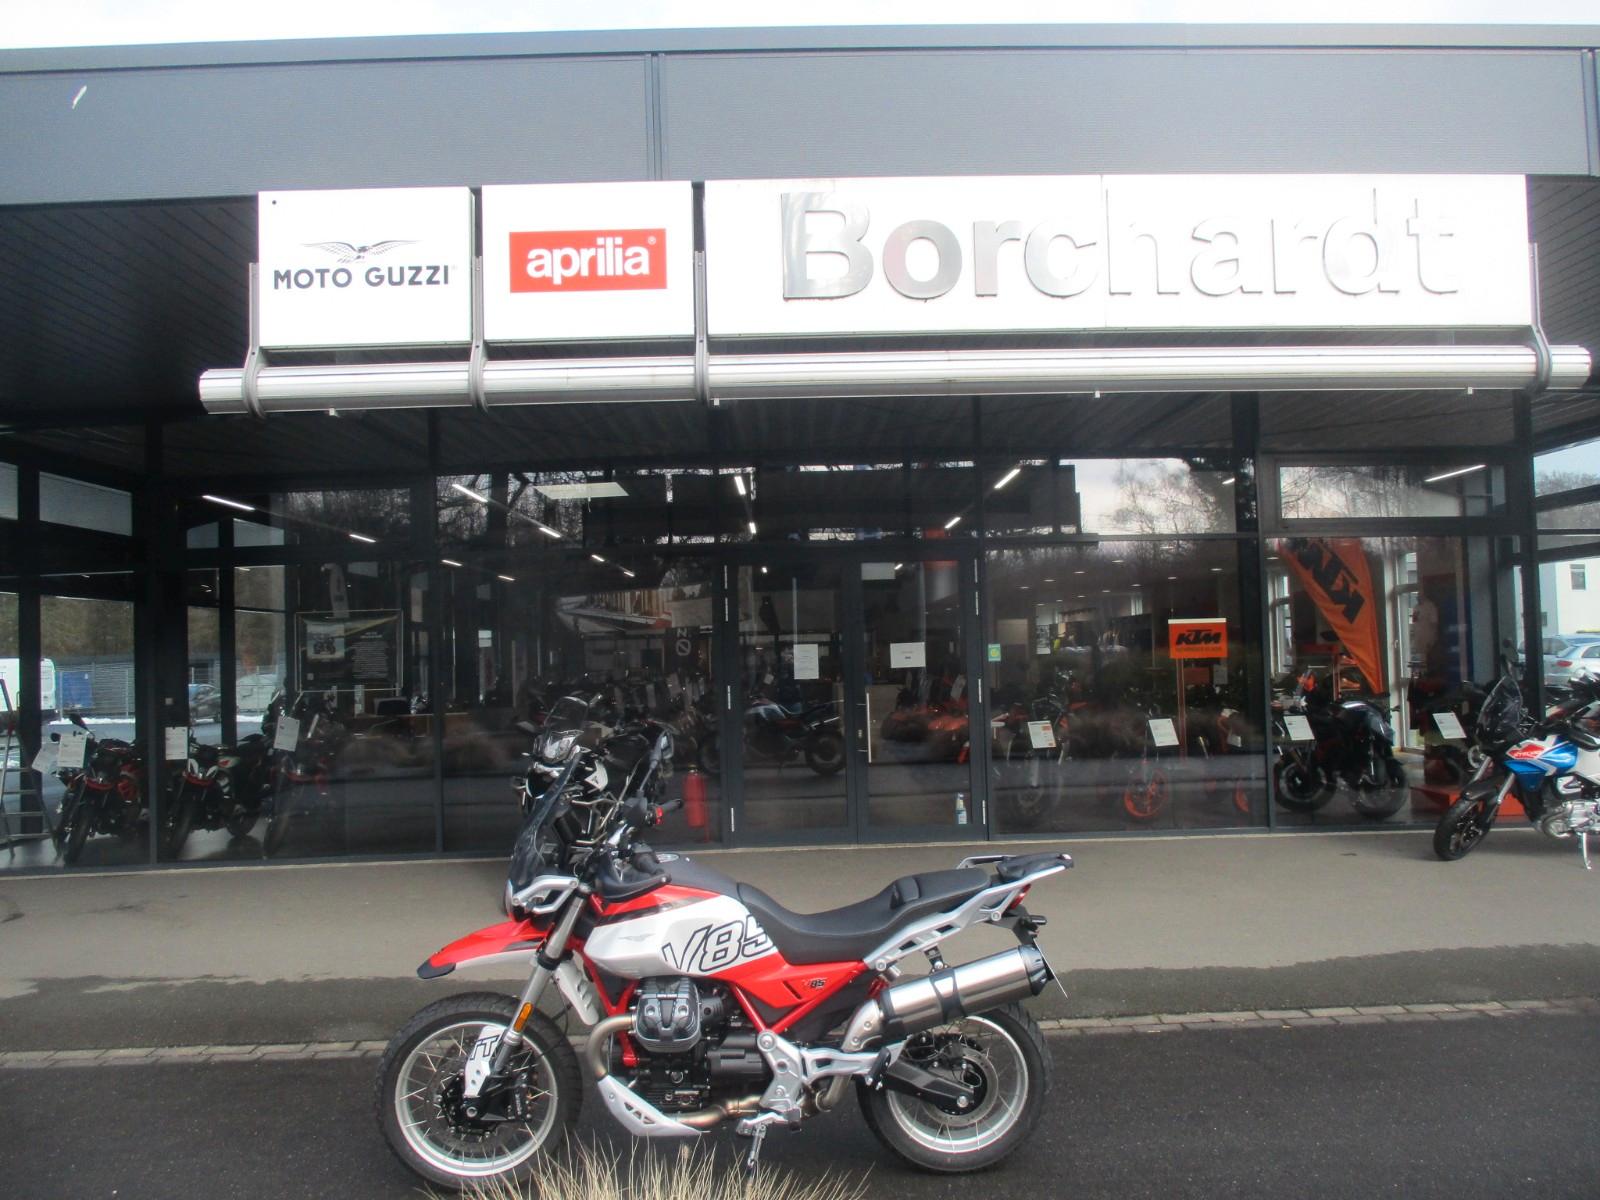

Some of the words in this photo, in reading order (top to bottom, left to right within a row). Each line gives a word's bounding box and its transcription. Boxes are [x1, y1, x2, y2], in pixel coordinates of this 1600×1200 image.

[526, 236, 650, 285] aprilia
[780, 189, 1458, 299] Borchardt
[274, 268, 353, 289] MOTO
[365, 265, 449, 287] GUZZI
[1175, 629, 1222, 645] KTM
